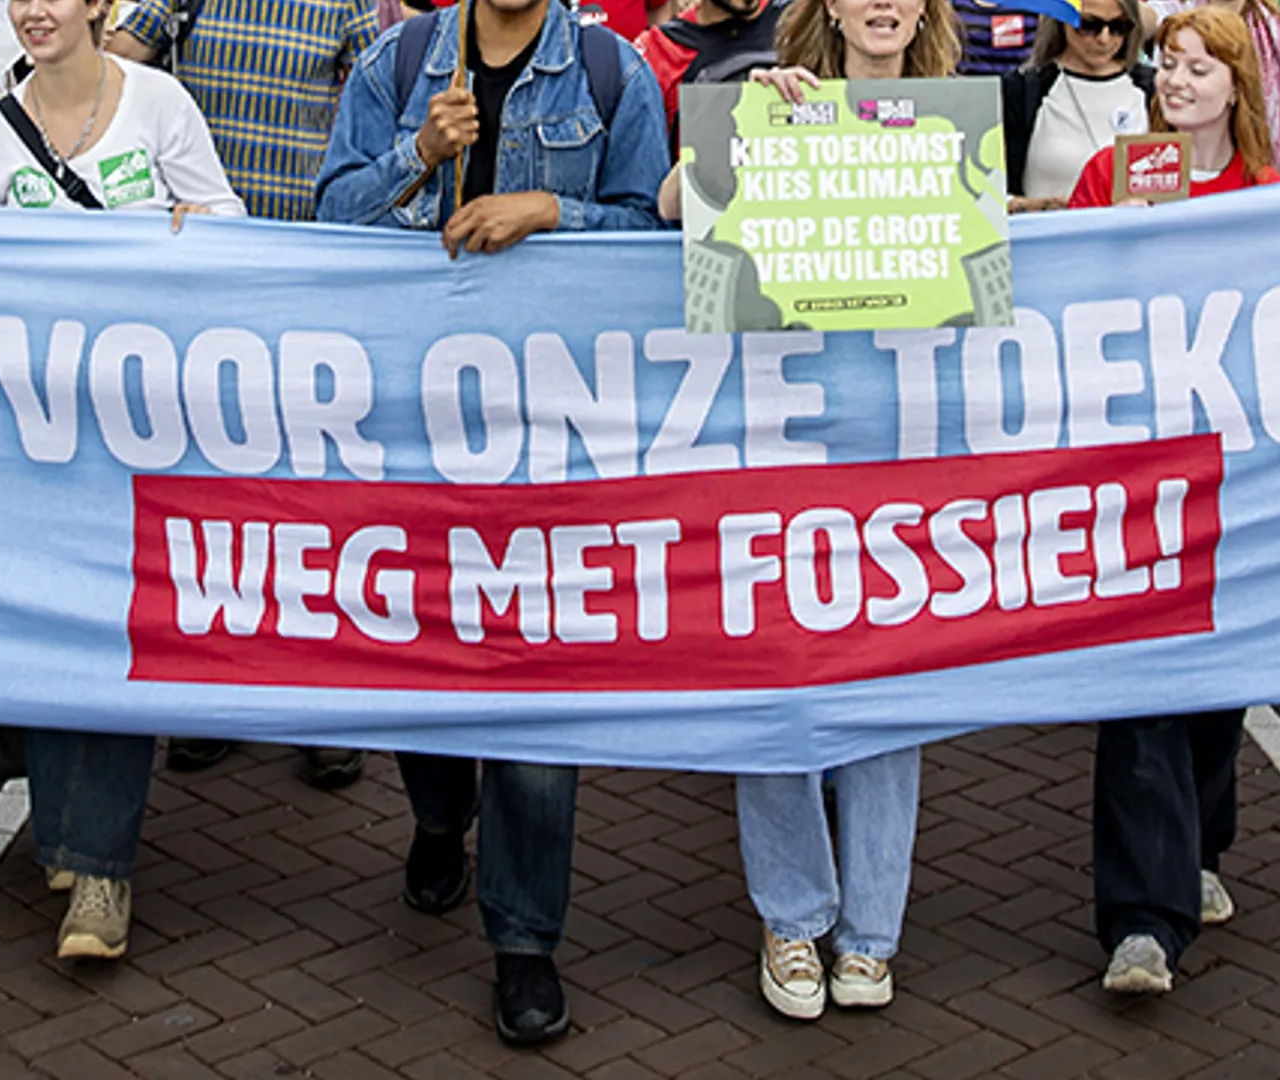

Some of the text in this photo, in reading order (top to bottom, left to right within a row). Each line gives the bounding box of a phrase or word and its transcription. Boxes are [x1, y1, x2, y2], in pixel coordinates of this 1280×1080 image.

[730, 132, 966, 167] KIES TOEKOMST
[744, 166, 954, 201] KIES KLIMAAT
[740, 213, 962, 249] STOP DE GROTE
[753, 249, 950, 283] VERVUILERS!
[422, 328, 828, 486] ONZE
[165, 478, 1188, 644] WEG MET FOSSIEL!
